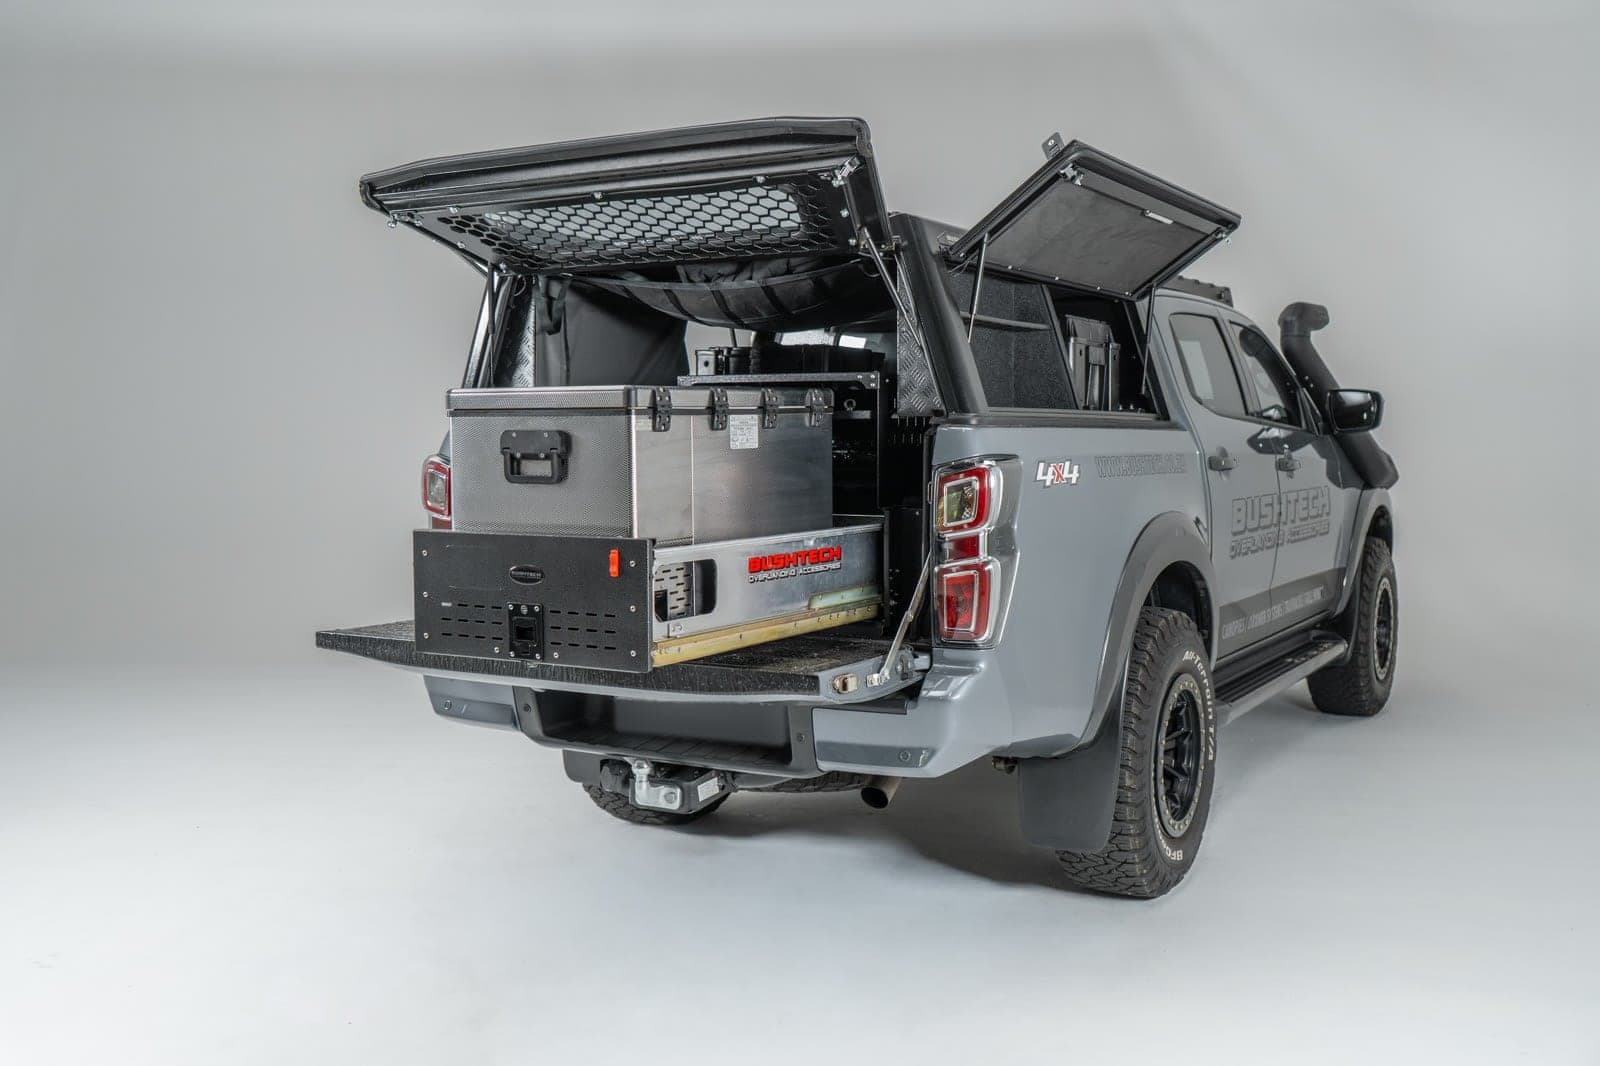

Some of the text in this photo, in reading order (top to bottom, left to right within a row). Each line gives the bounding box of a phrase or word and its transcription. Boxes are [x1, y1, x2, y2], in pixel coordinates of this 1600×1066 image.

[1231, 486, 1331, 537] BUSHTECH
[748, 544, 842, 574] BUSHTECH
[748, 561, 841, 584] OVERLANDING ACCESSORIES
